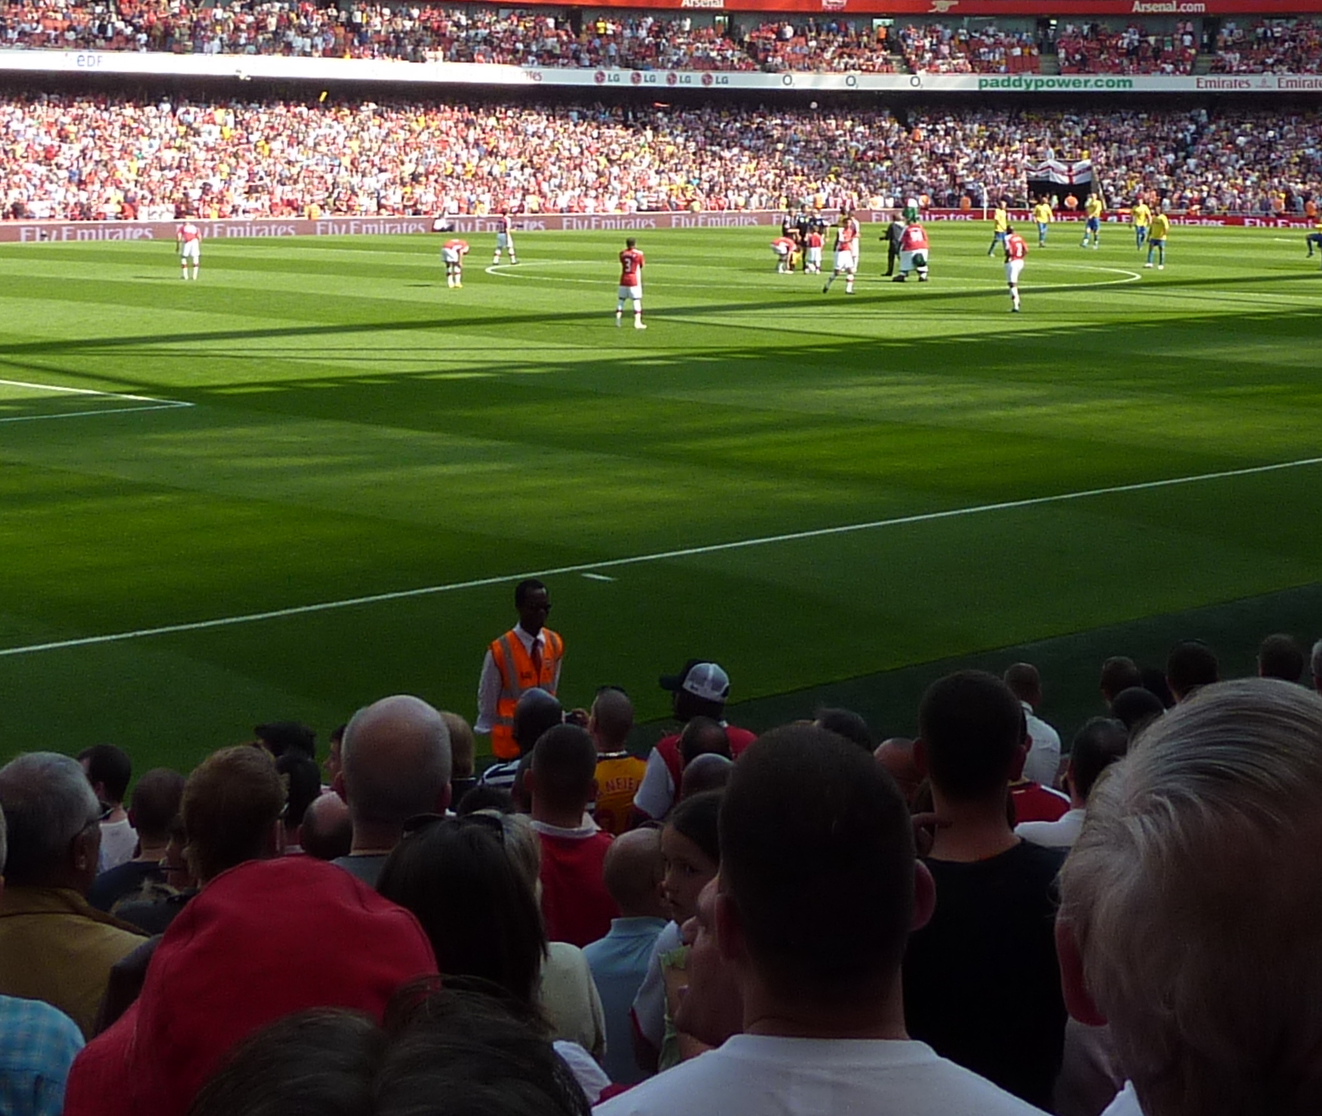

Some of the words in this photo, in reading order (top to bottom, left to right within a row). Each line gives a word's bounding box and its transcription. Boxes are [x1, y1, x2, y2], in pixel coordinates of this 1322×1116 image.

[1132, 0, 1205, 13] Arsenal.com
[607, 74, 620, 83] LG
[644, 75, 656, 84] LG
[679, 75, 691, 84] LG
[715, 76, 728, 85] LG
[978, 75, 1133, 90] paddypower.com
[1196, 77, 1251, 89] Emirates
[316, 222, 347, 235] Fly
[351, 220, 425, 234] Emirates
[563, 218, 590, 230] Fly
[593, 216, 655, 229] Emirates
[672, 216, 696, 228] Fly
[699, 214, 758, 227] Emirates
[1243, 217, 1273, 228] Fly
[61, 225, 153, 241] Emirates
[213, 222, 296, 237] Emirates
[624, 258, 632, 272] 3
